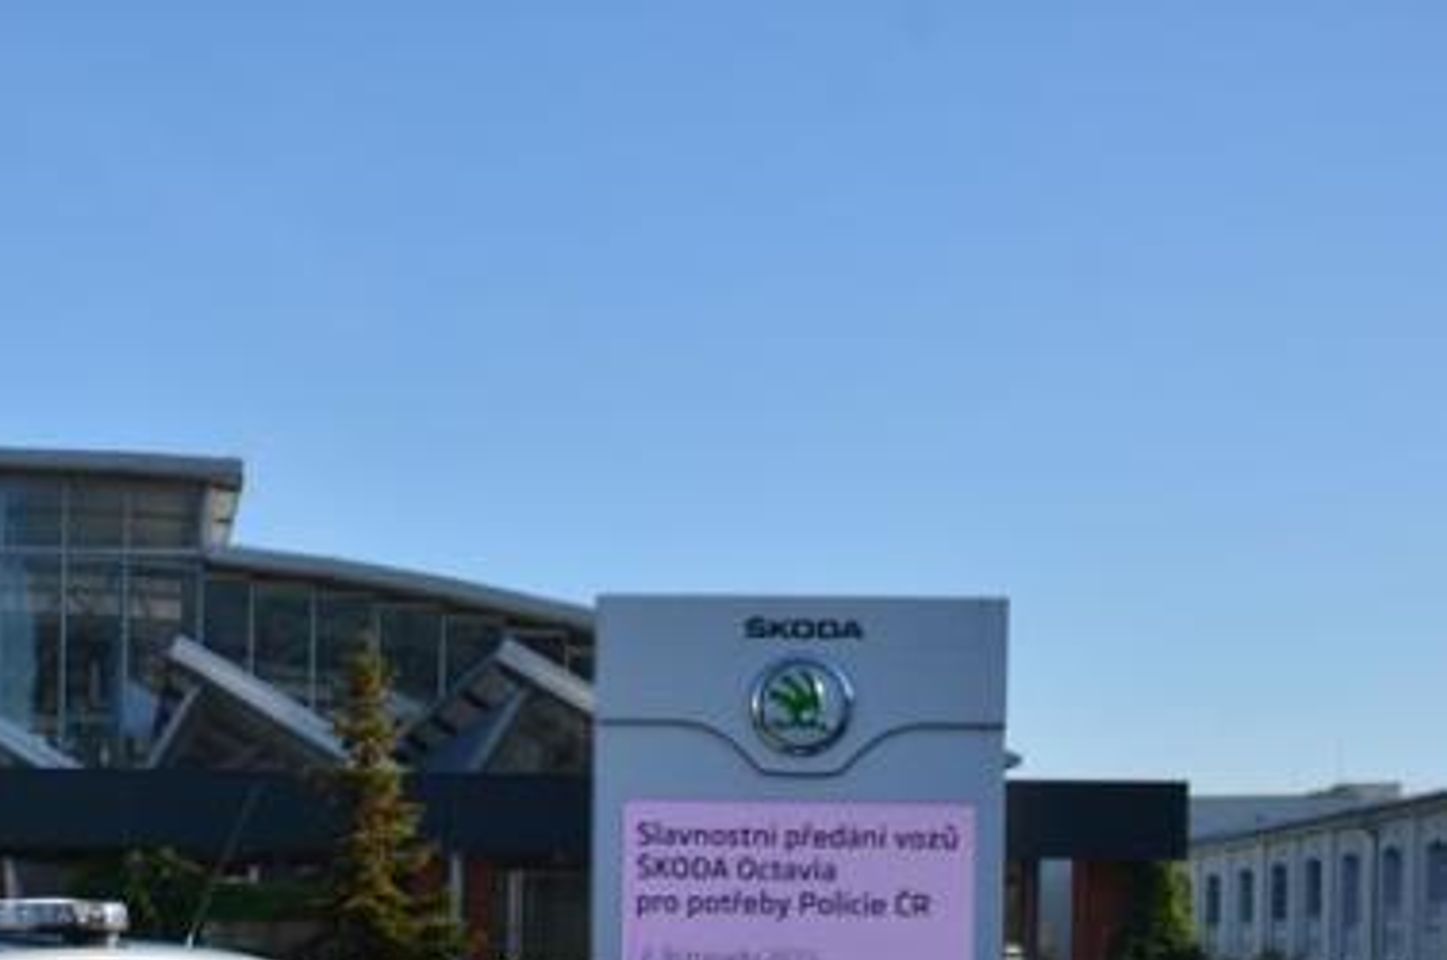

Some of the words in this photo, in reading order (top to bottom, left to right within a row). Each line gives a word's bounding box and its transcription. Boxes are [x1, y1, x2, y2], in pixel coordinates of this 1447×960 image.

[894, 825, 959, 850] vozů
[635, 854, 728, 882] ŠKODA
[736, 856, 838, 882] Octavia
[635, 895, 681, 919] pro
[686, 891, 791, 921] potřeby
[798, 891, 887, 917] Policie
[893, 889, 932, 918] ČR
